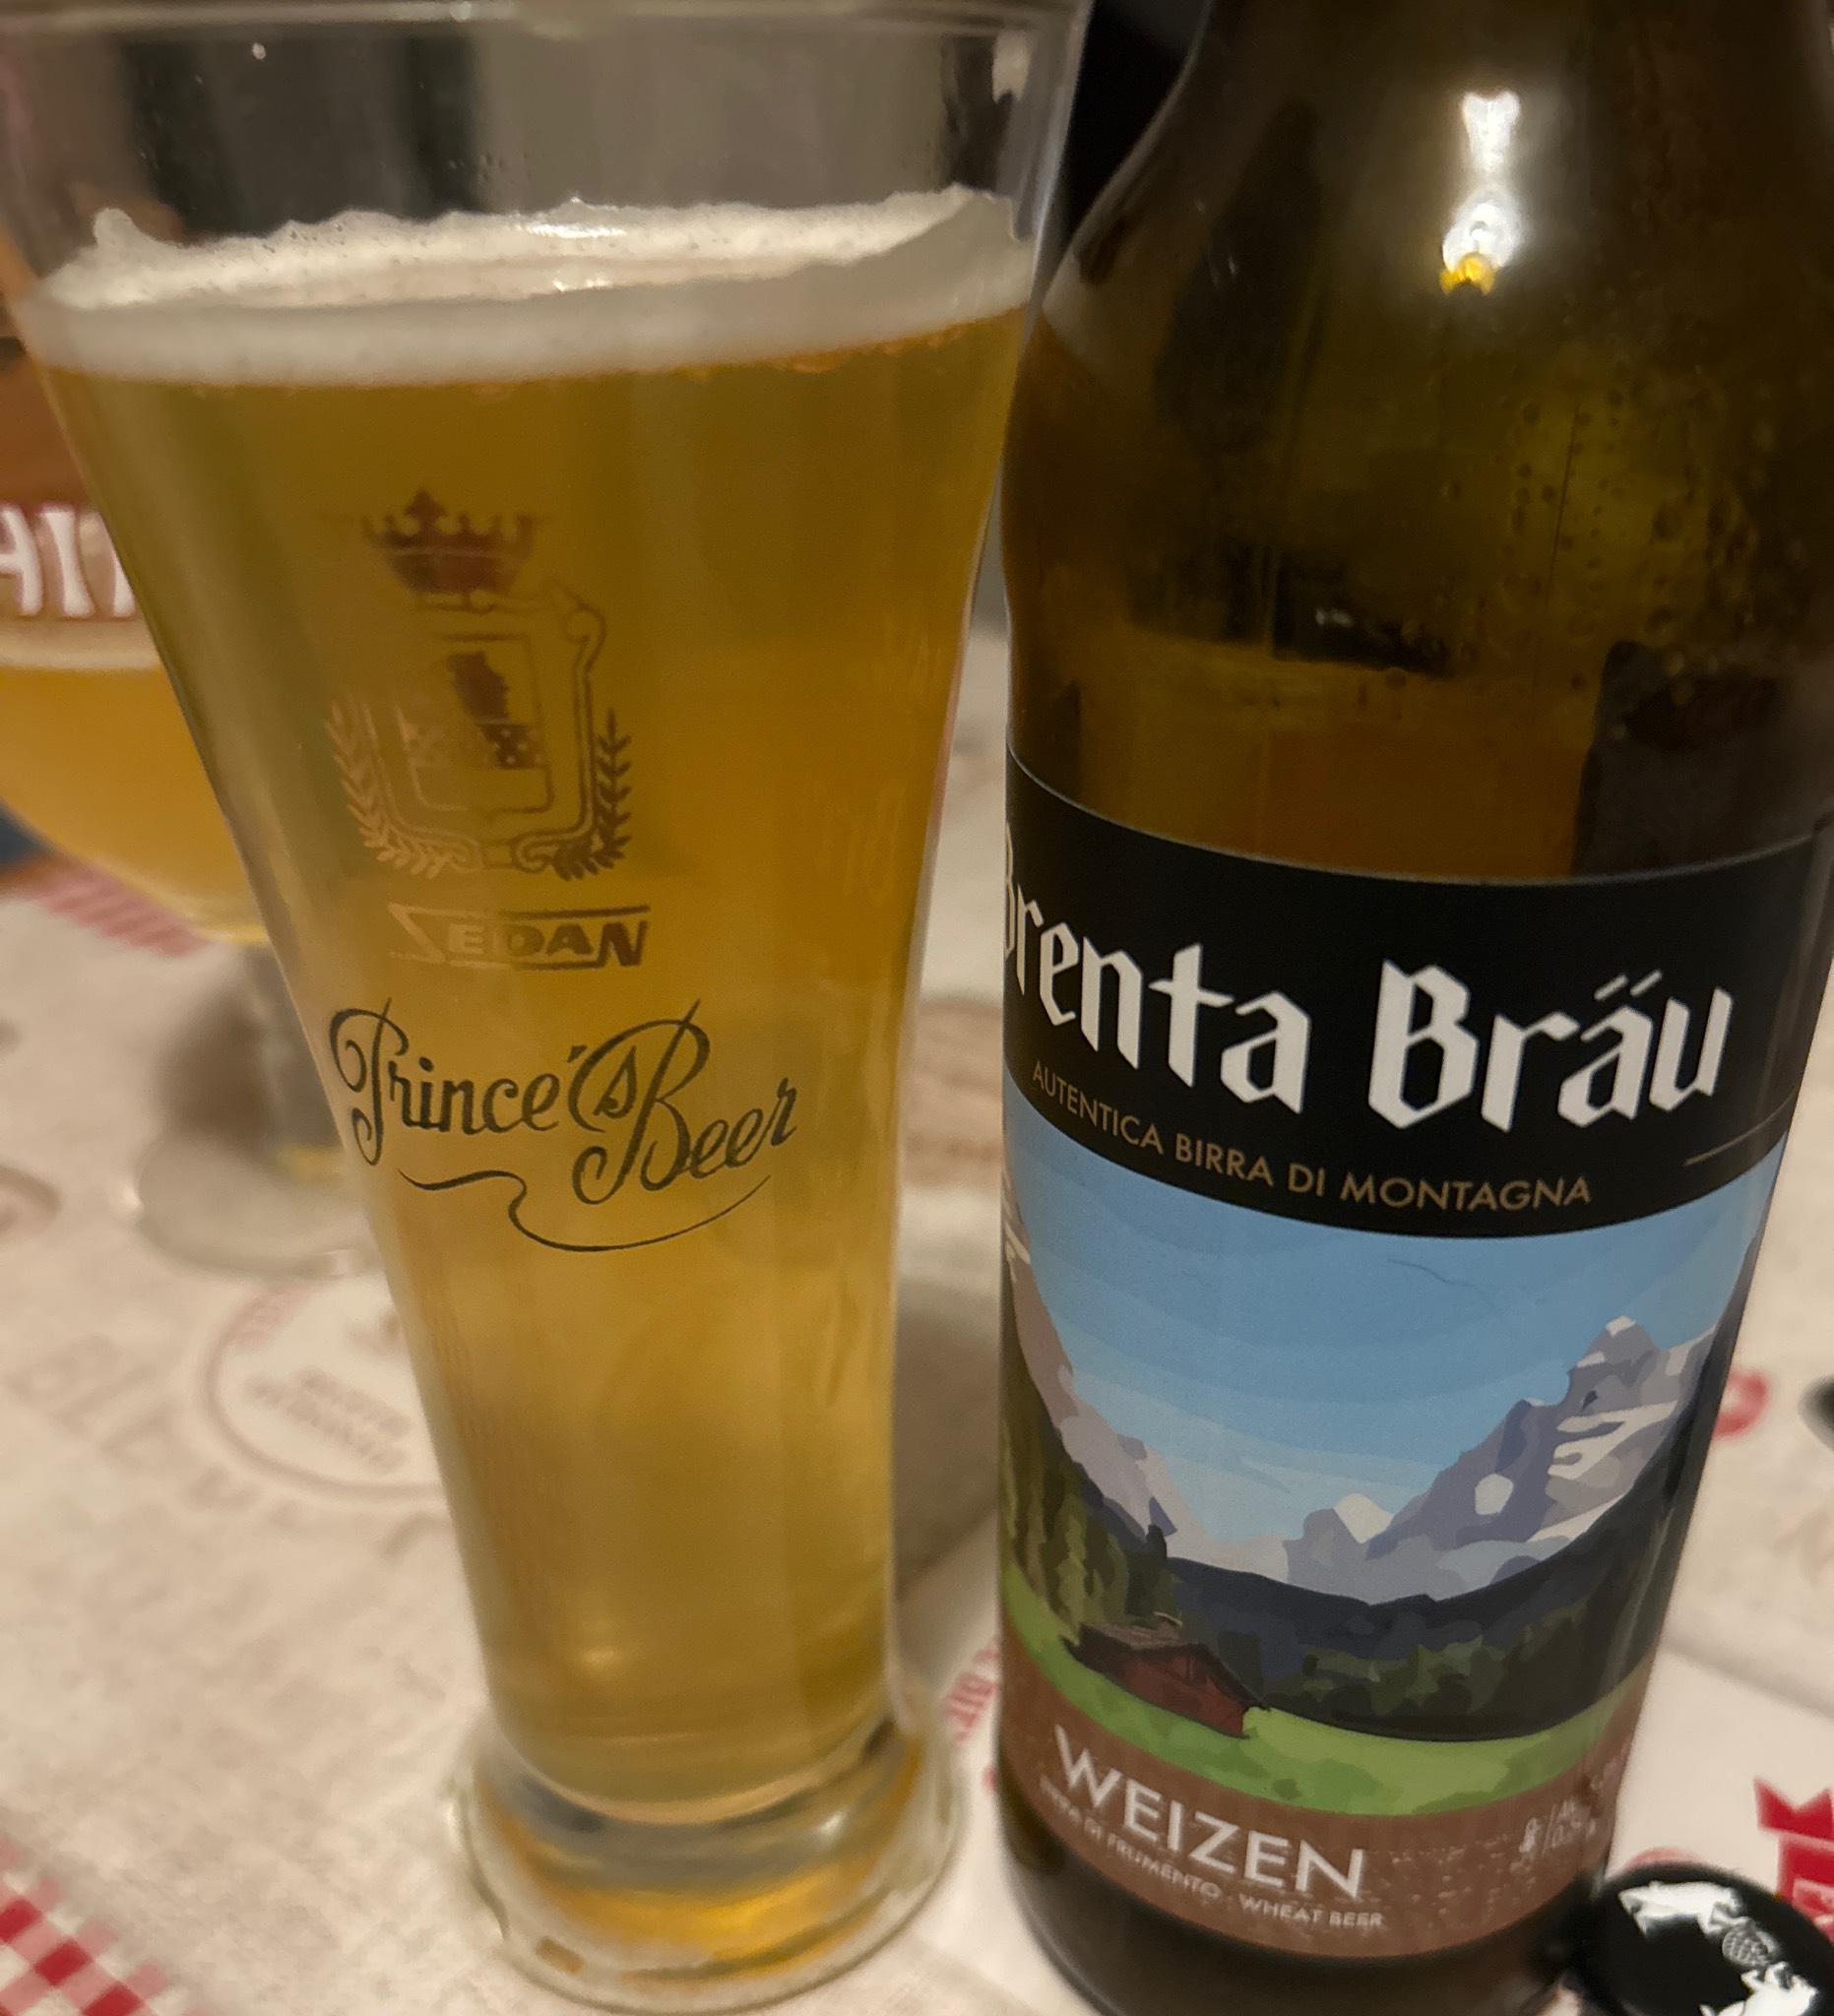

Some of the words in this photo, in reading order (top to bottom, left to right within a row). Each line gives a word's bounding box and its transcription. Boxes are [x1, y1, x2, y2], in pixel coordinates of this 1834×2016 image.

[567, 998, 797, 1206] Beer
[1368, 959, 1732, 1133] Bräu
[1033, 1060, 1164, 1156] AUTENTICA
[1174, 1132, 1274, 1187] BIRRA
[1288, 1163, 1325, 1198] DI
[1339, 1173, 1591, 1212] MONTAGNA
[1054, 1724, 1365, 1901] WEIZEN
[1239, 1892, 1322, 1924] WHEAT
[1329, 1910, 1385, 1928] BEER
